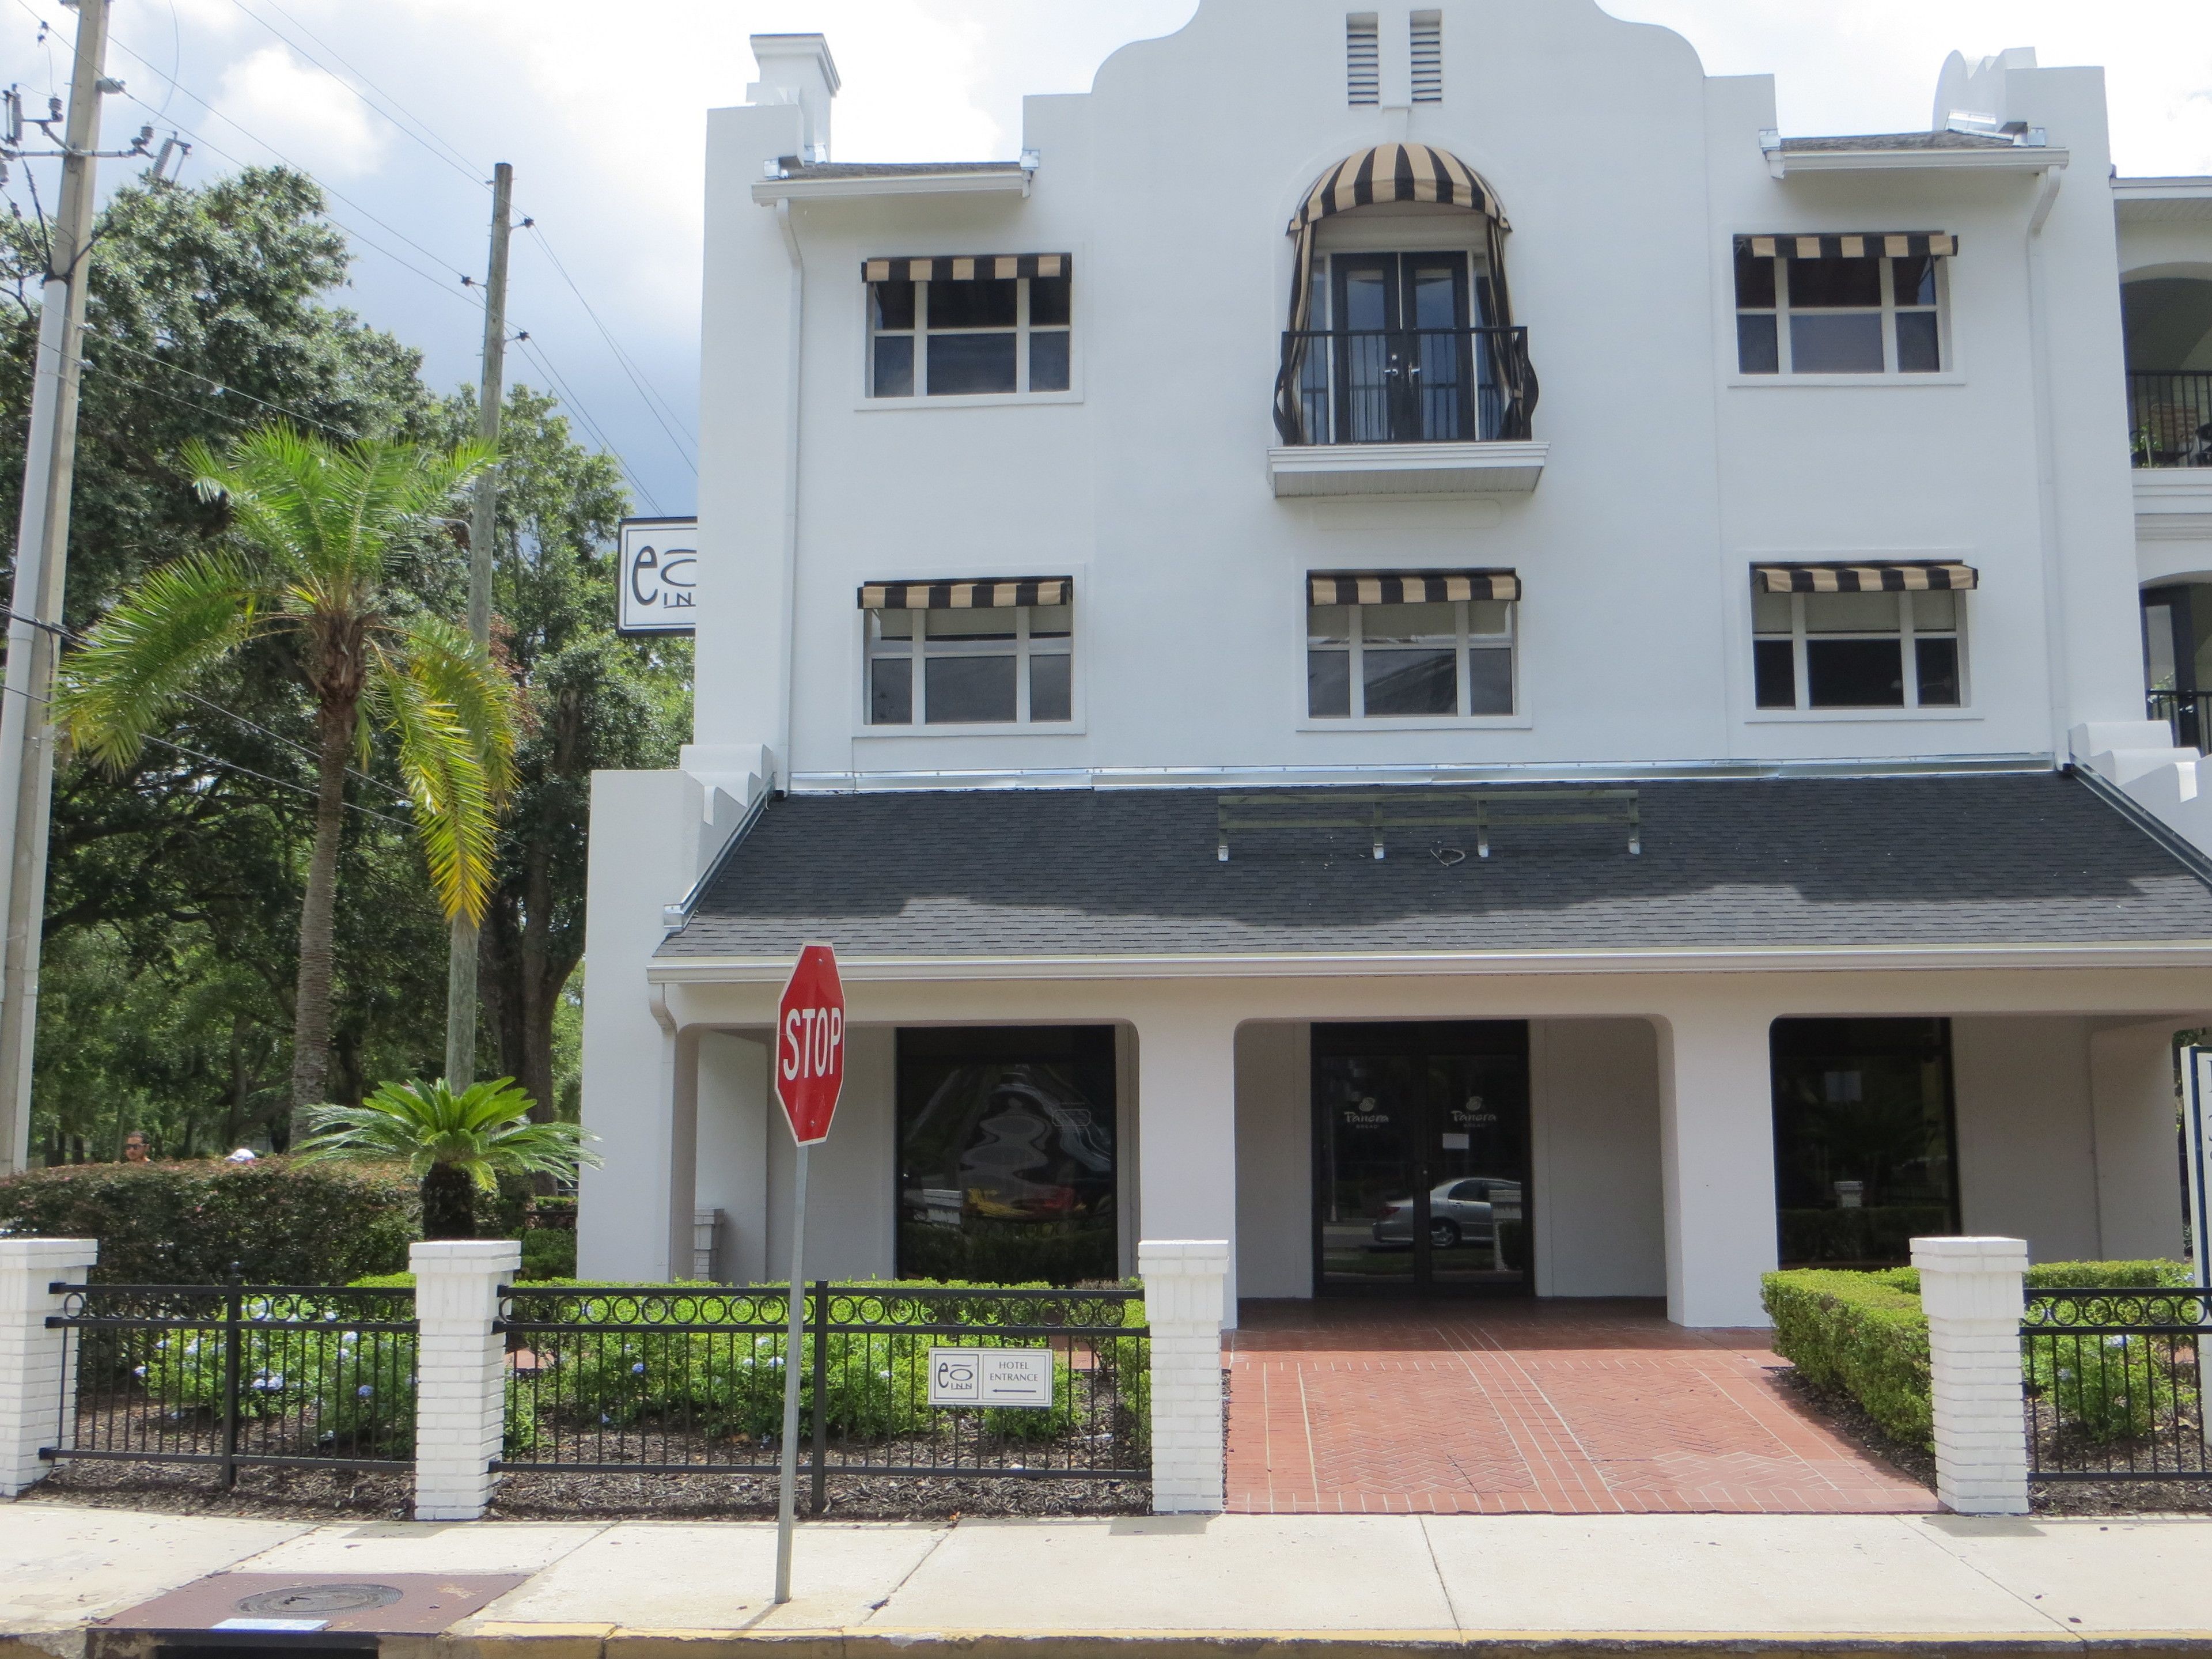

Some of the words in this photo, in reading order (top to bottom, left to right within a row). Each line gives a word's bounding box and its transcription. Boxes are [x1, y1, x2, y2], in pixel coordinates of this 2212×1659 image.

[783, 1007, 841, 1081] STOP
[1344, 1111, 1389, 1123] Panera
[1450, 1110, 1497, 1122] Panera
[999, 1361, 1029, 1370] HOTEL
[990, 1373, 1038, 1382] ENTRANCE
